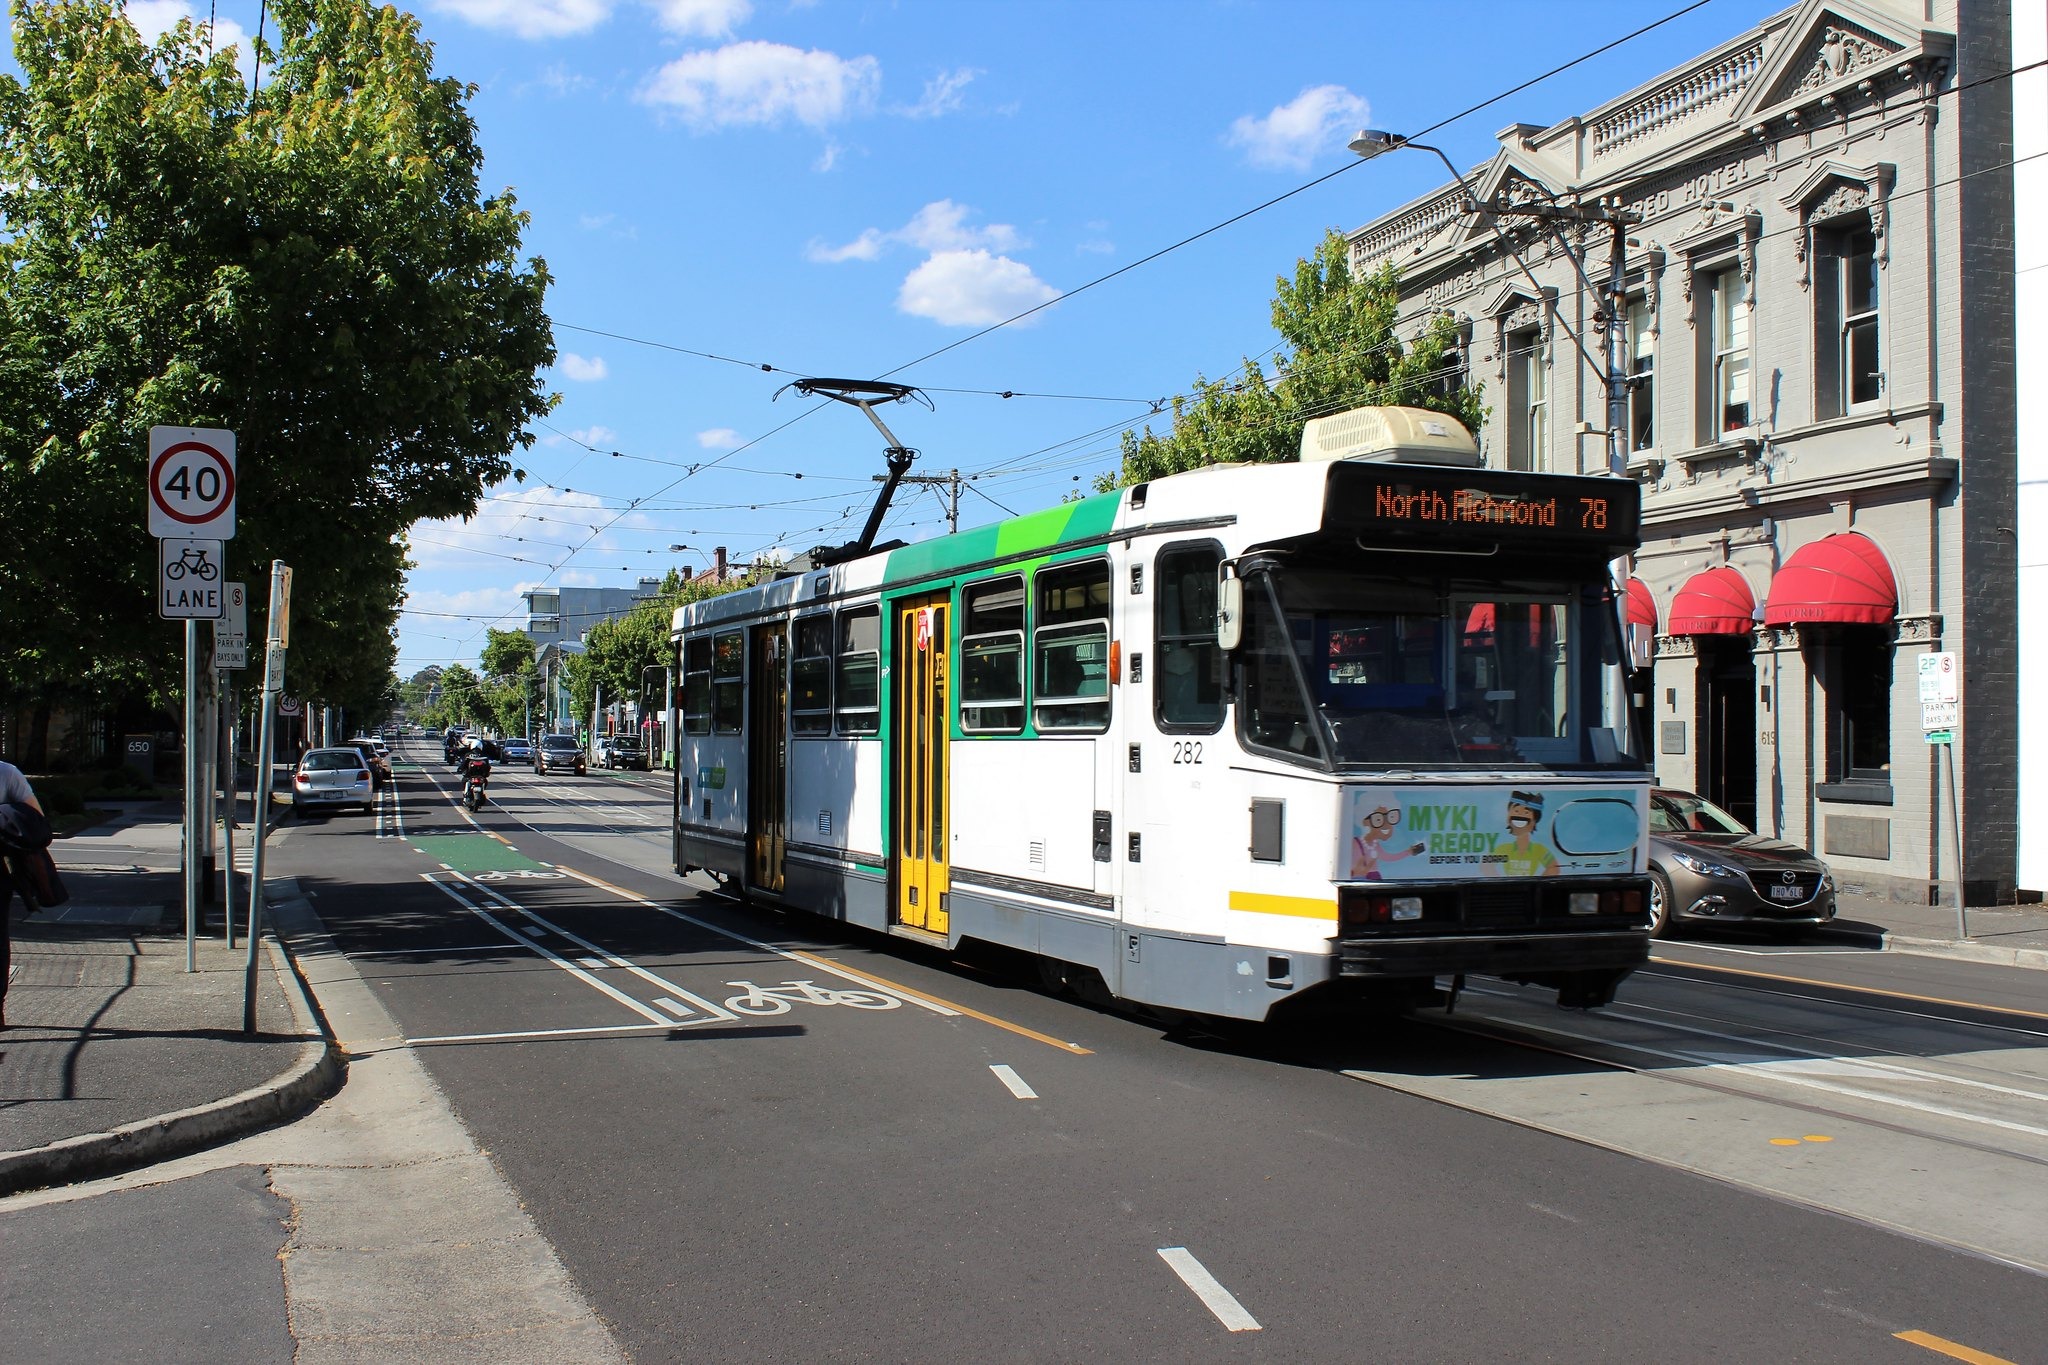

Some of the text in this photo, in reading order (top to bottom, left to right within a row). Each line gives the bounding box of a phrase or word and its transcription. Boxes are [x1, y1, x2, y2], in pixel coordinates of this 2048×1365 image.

[1684, 159, 1749, 202] HOTEL
[164, 465, 220, 502] 40
[1376, 485, 1607, 529] North Richmond 78
[166, 589, 218, 608] LANE
[217, 639, 244, 649] PARK IN
[217, 652, 244, 662] BAYS ONLY
[1921, 658, 1937, 670] 2P
[283, 696, 296, 708] 40
[1925, 703, 1945, 712] PARK
[1925, 715, 1942, 725] BAYS
[128, 741, 150, 752] 650
[1173, 741, 1203, 764] 282
[1408, 805, 1478, 831] MYKI
[1430, 832, 1500, 854] READY
[1429, 854, 1509, 864] BEFORE YOU BOARD
